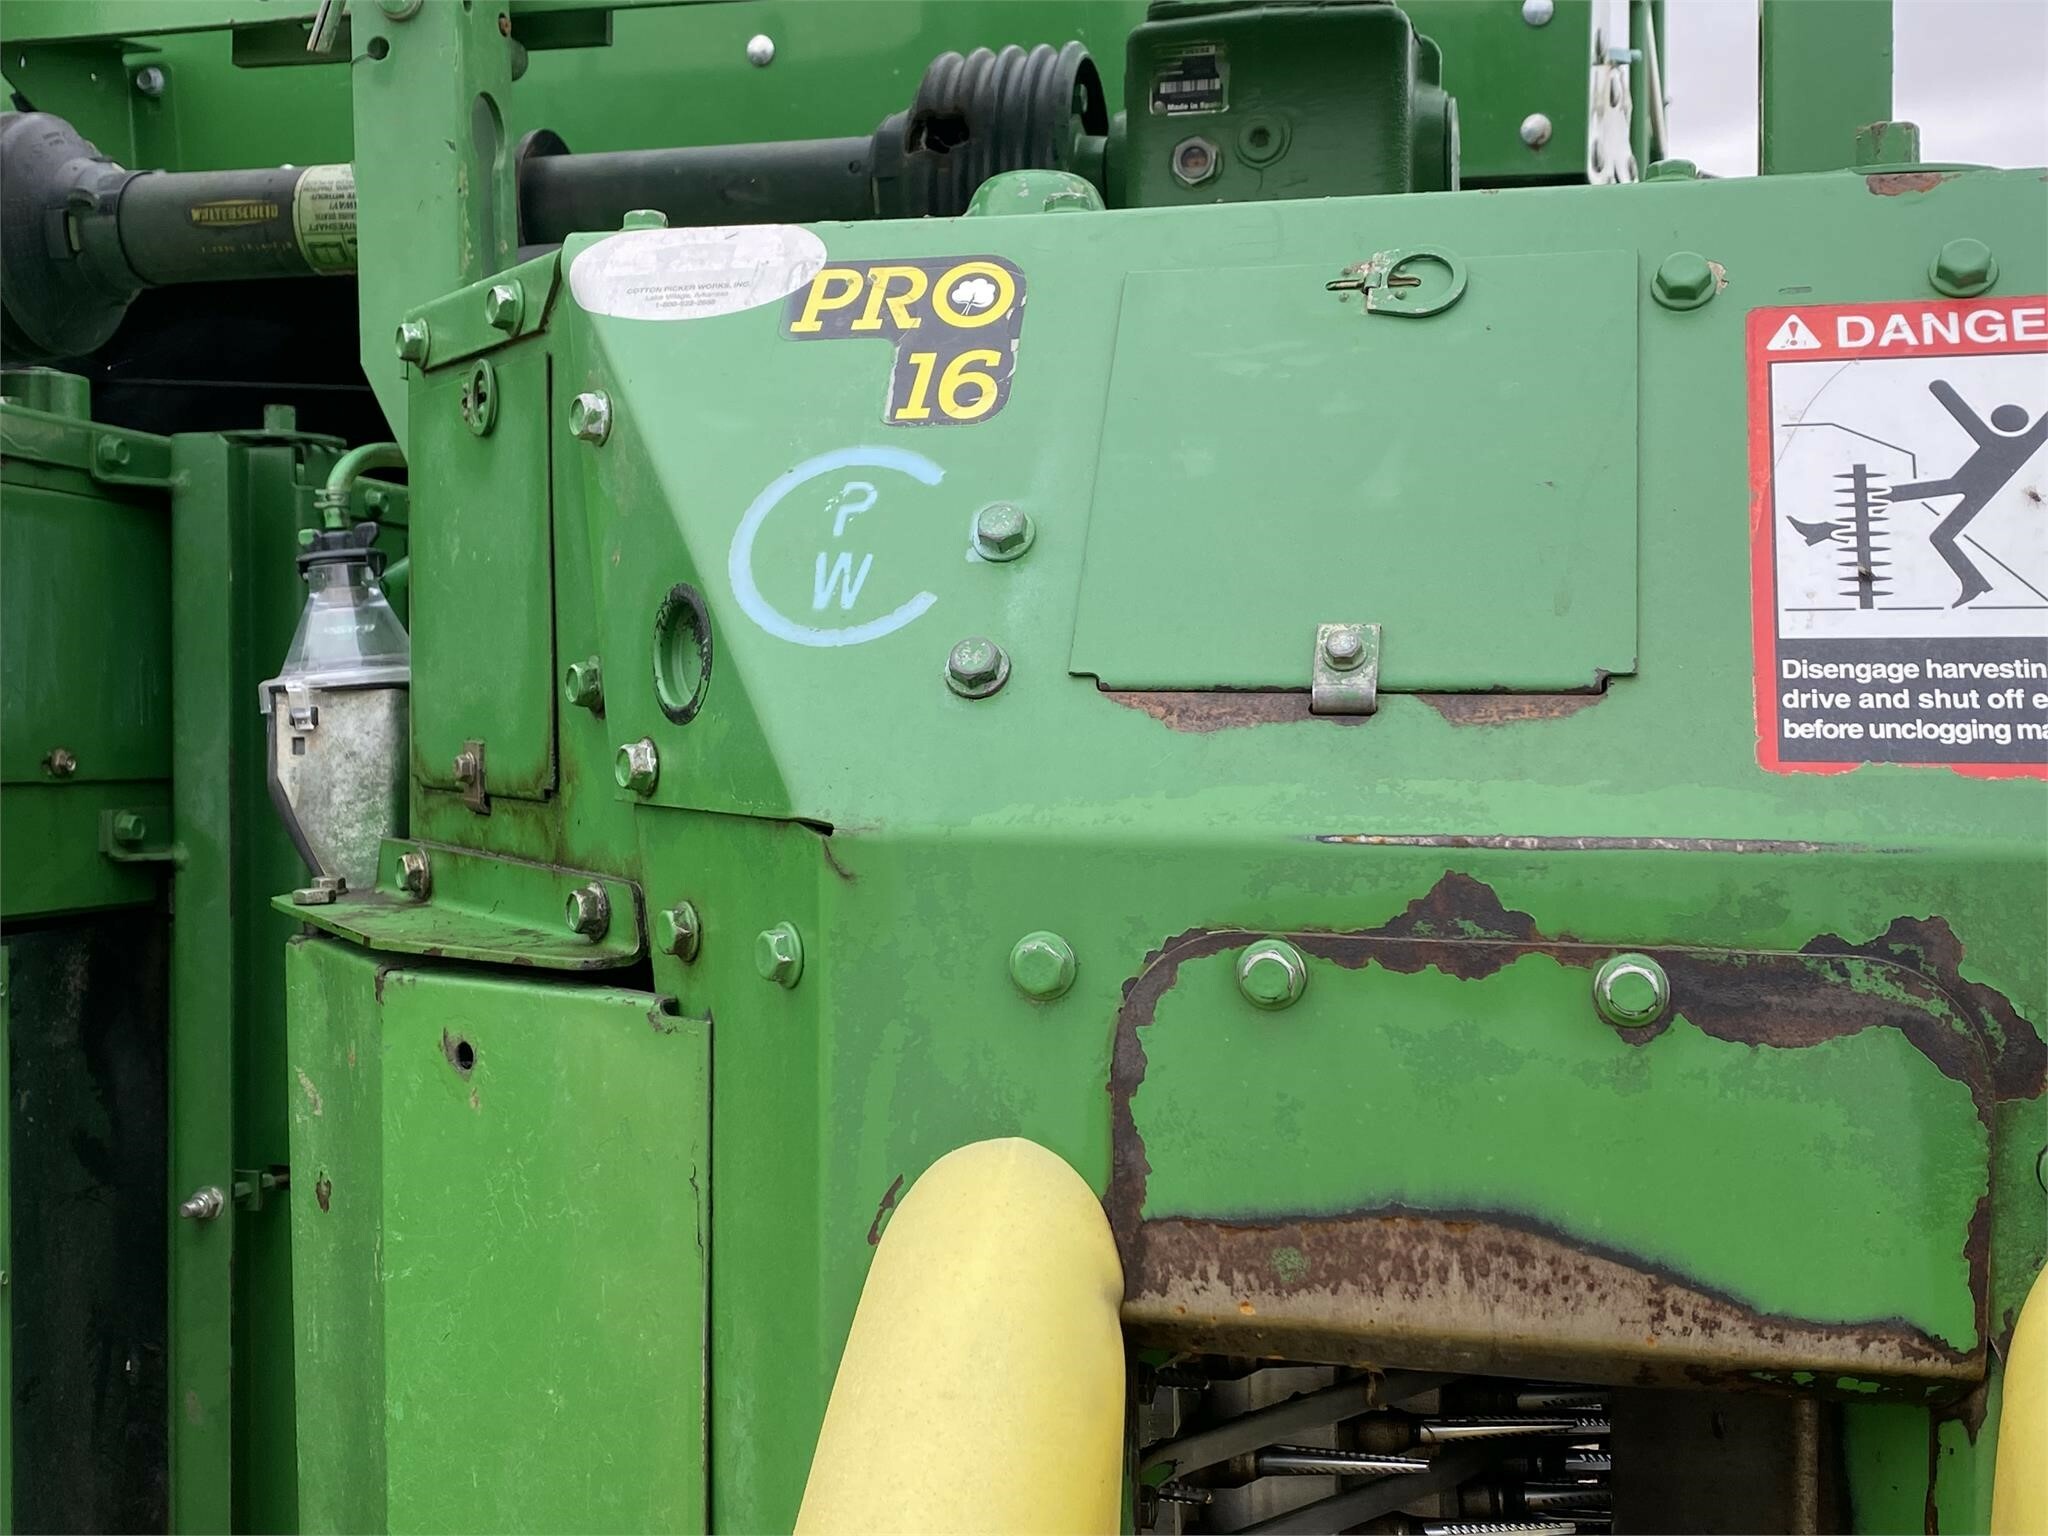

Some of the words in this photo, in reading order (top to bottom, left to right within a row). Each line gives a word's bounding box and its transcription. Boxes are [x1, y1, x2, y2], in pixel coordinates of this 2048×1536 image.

[626, 286, 662, 295] COTTON
[664, 284, 696, 292] PICKER
[790, 262, 1015, 332] PRO
[1837, 308, 2048, 348] DANGE
[895, 349, 1001, 420] 16
[833, 481, 878, 537] P
[812, 552, 873, 610] W
[1782, 659, 1920, 684] Disengage
[1926, 658, 2048, 679] harvestin
[1782, 689, 1851, 709] drive
[1859, 689, 1910, 709] and
[1918, 688, 1981, 709] shut
[1987, 688, 2025, 709] off
[1783, 718, 1864, 739] before
[1869, 718, 2011, 744] unclogging
